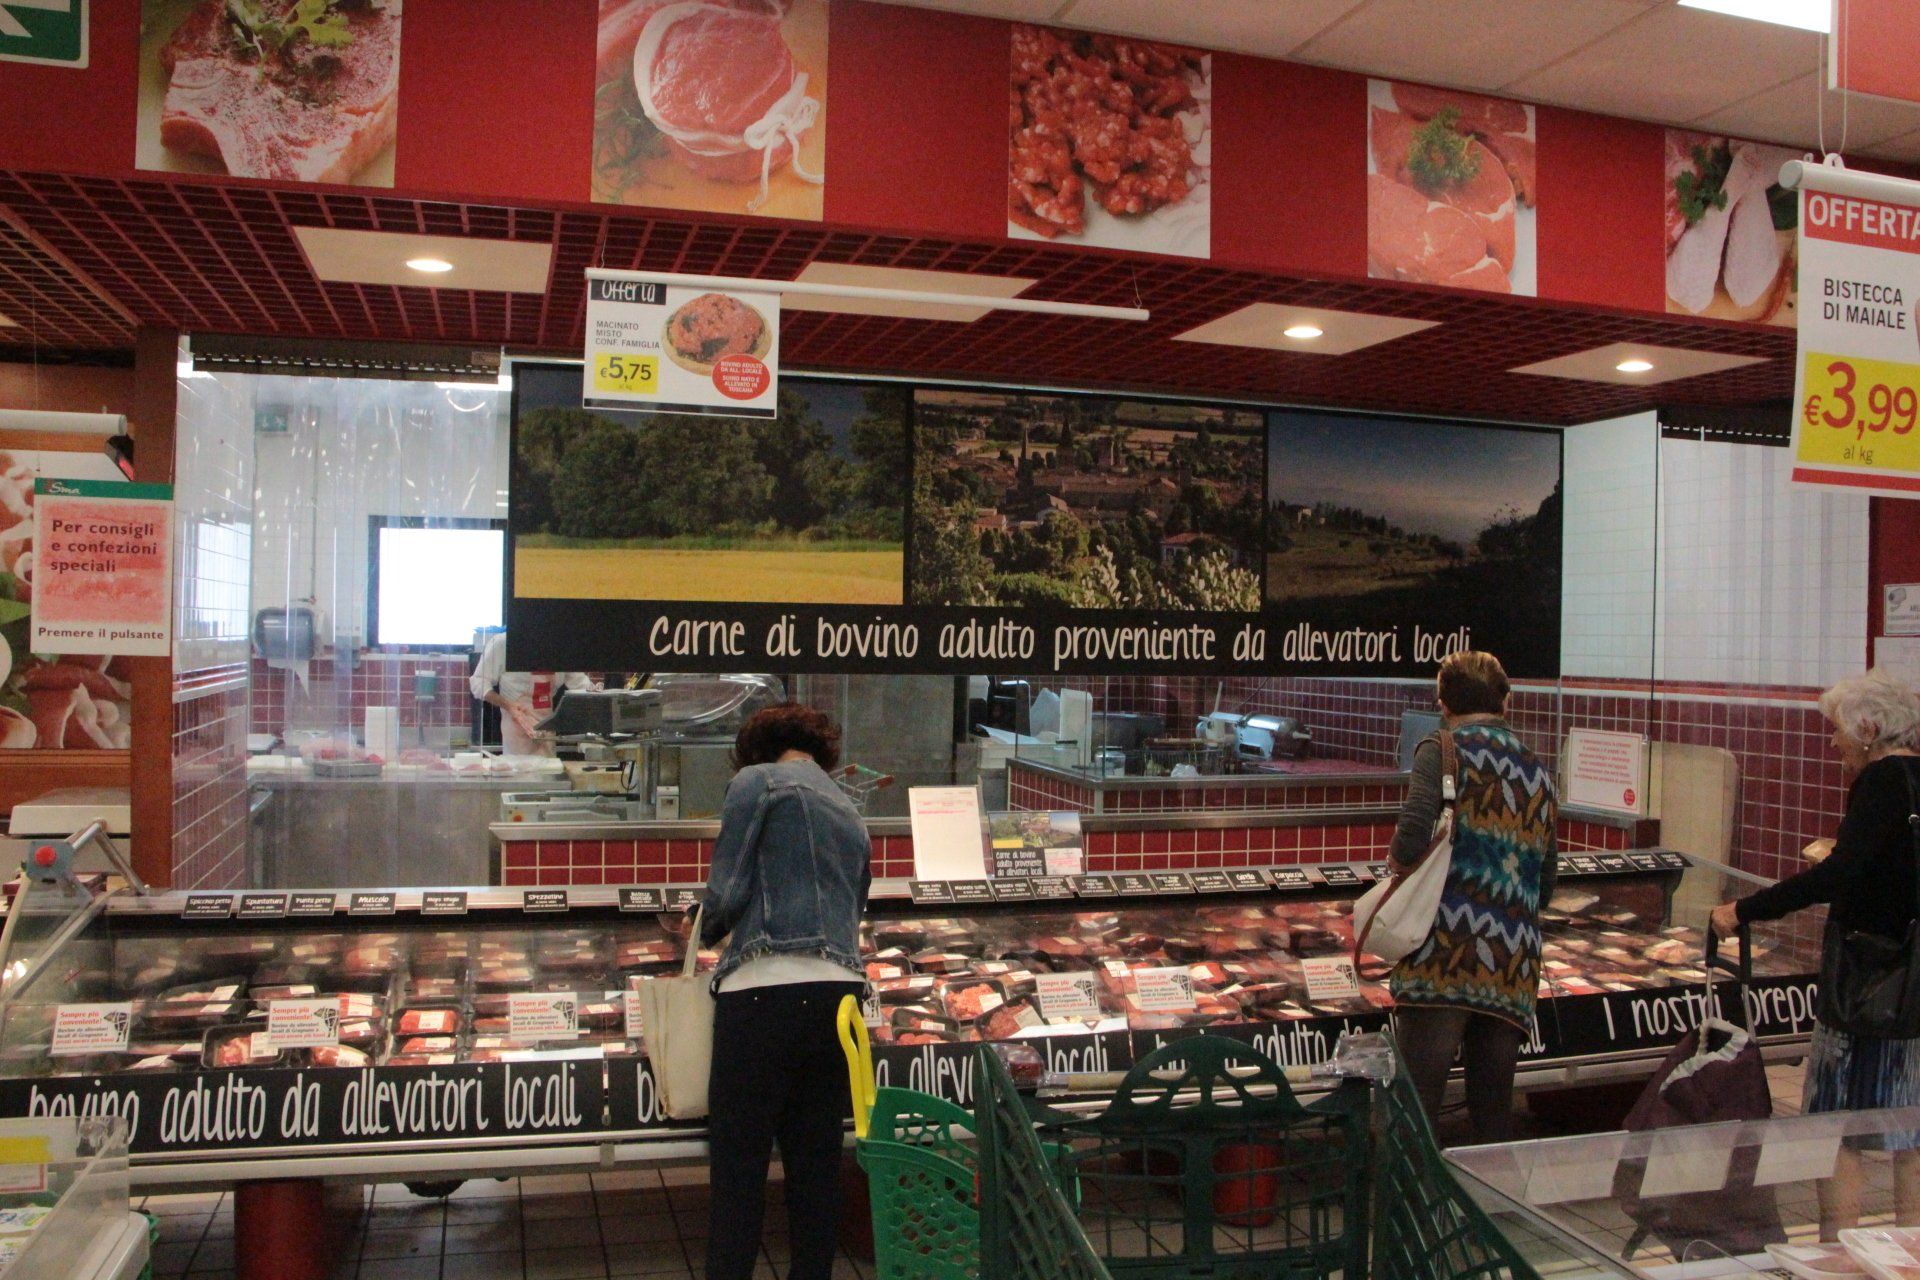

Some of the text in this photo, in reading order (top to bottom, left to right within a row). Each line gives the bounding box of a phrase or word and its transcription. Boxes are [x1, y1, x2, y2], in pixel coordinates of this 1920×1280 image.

[601, 280, 655, 302] Offerta
[1823, 277, 1904, 307] BISTECCA
[596, 320, 639, 331] MACINATO
[1823, 301, 1907, 330] DI MAIALE
[595, 329, 622, 338] MISTO
[595, 338, 660, 349] CONF. FAMIGLIA
[600, 356, 652, 382] €5,75
[1804, 360, 1918, 441] €3,99
[1843, 445, 1873, 465] al kg
[49, 482, 81, 495] Sma
[52, 520, 154, 539] Per consigli
[51, 541, 157, 555] e confezioni
[50, 560, 116, 574] speciali
[38, 627, 164, 641] Premere il pulsante
[649, 614, 1471, 671] Carne di bovino adulto proveniente da allevatori locali
[1602, 996, 1615, 1041] I
[1631, 984, 1723, 1039] nostri
[160, 1071, 267, 1144] adulto
[280, 1072, 321, 1139] da
[341, 1067, 488, 1136] allevatori
[504, 1063, 582, 1130] locali
